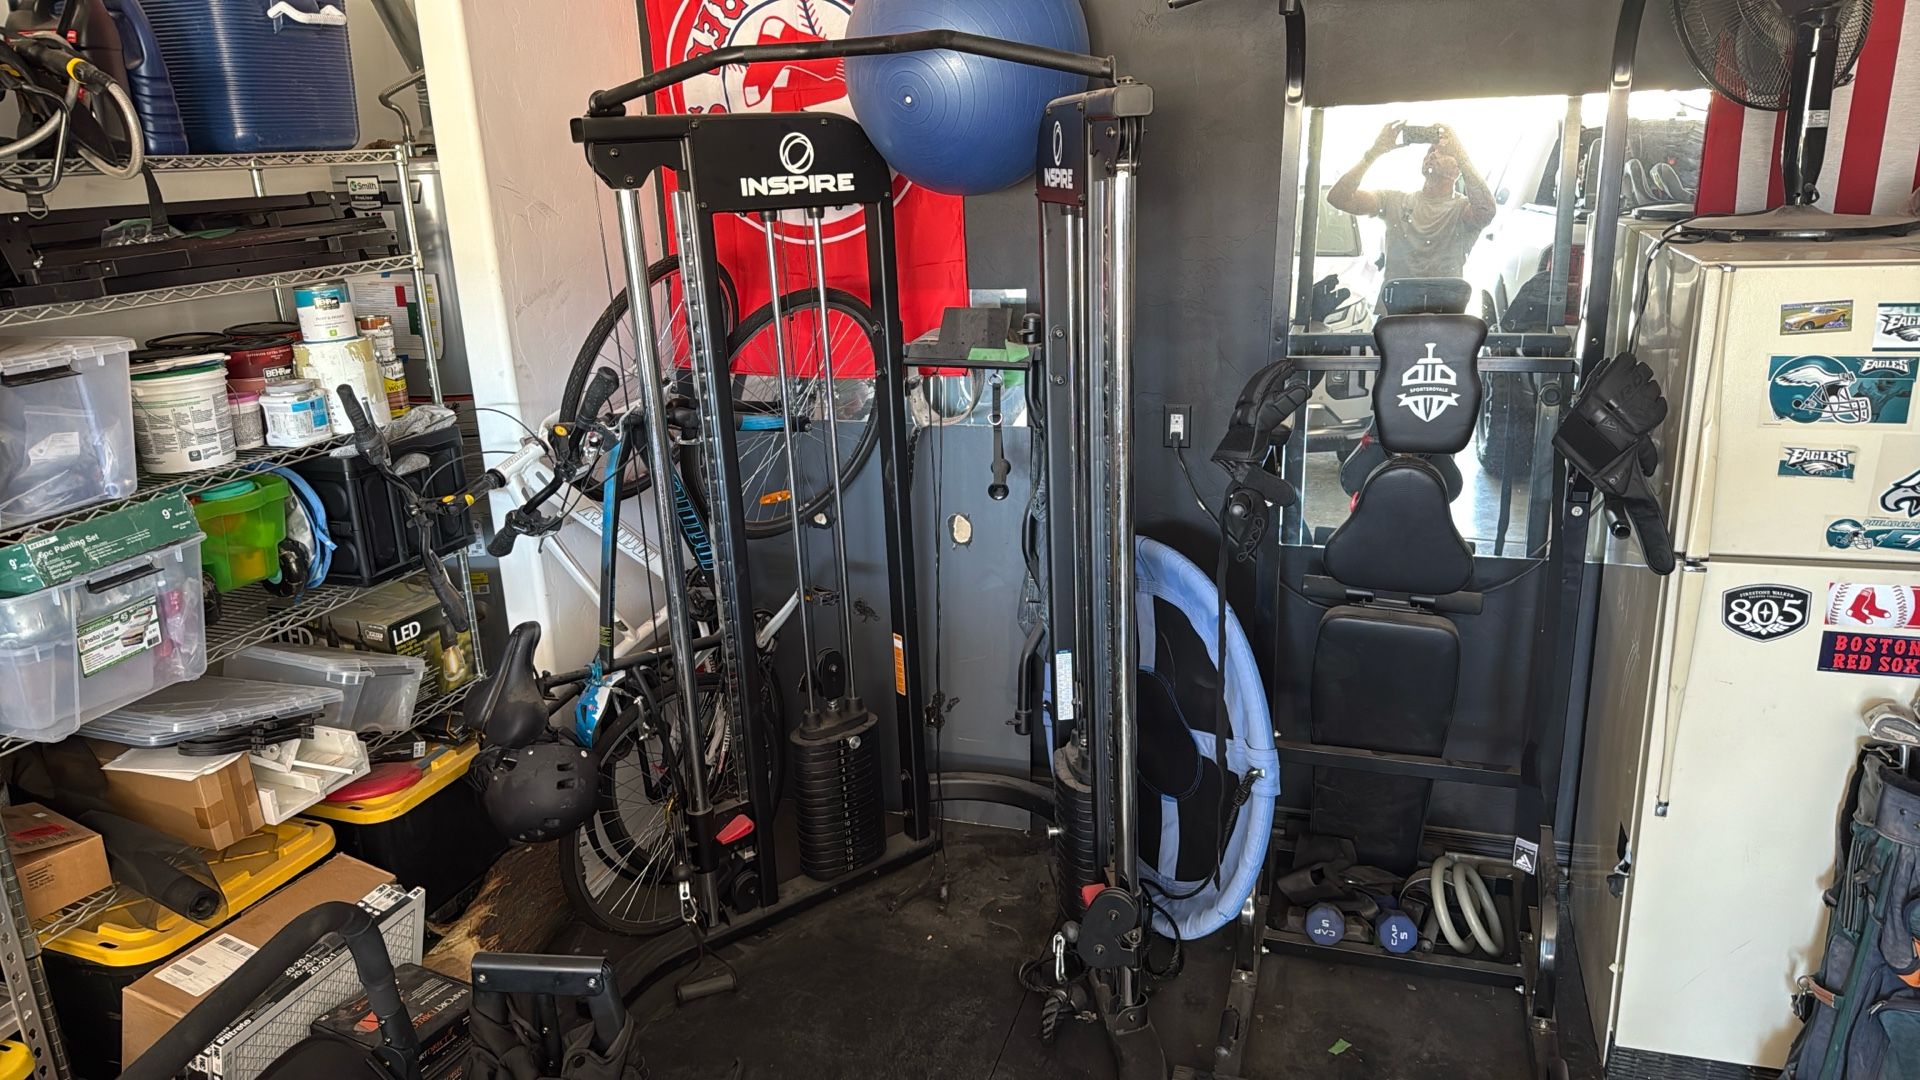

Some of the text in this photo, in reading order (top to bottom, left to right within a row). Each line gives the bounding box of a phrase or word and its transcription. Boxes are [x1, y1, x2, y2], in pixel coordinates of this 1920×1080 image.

[357, 182, 377, 191] Smith
[740, 173, 855, 197] INSPIRE
[1043, 167, 1074, 190] INSPIRE
[265, 367, 285, 378] BEHR
[1861, 358, 1909, 374] EAGLES
[1787, 448, 1849, 468] EAGLES
[37, 548, 54, 559] 6pc
[53, 537, 86, 555] Painting
[84, 532, 99, 543] Set
[1772, 590, 1794, 598] WALKER
[1728, 599, 1803, 626] 805
[393, 621, 420, 645] LED
[1834, 635, 1920, 656] BOSTON
[1833, 654, 1920, 674] RED SOX
[1400, 932, 1408, 940] 5
[307, 953, 337, 975] 20x20x1
[412, 988, 469, 1029] IMPORTDIREC
